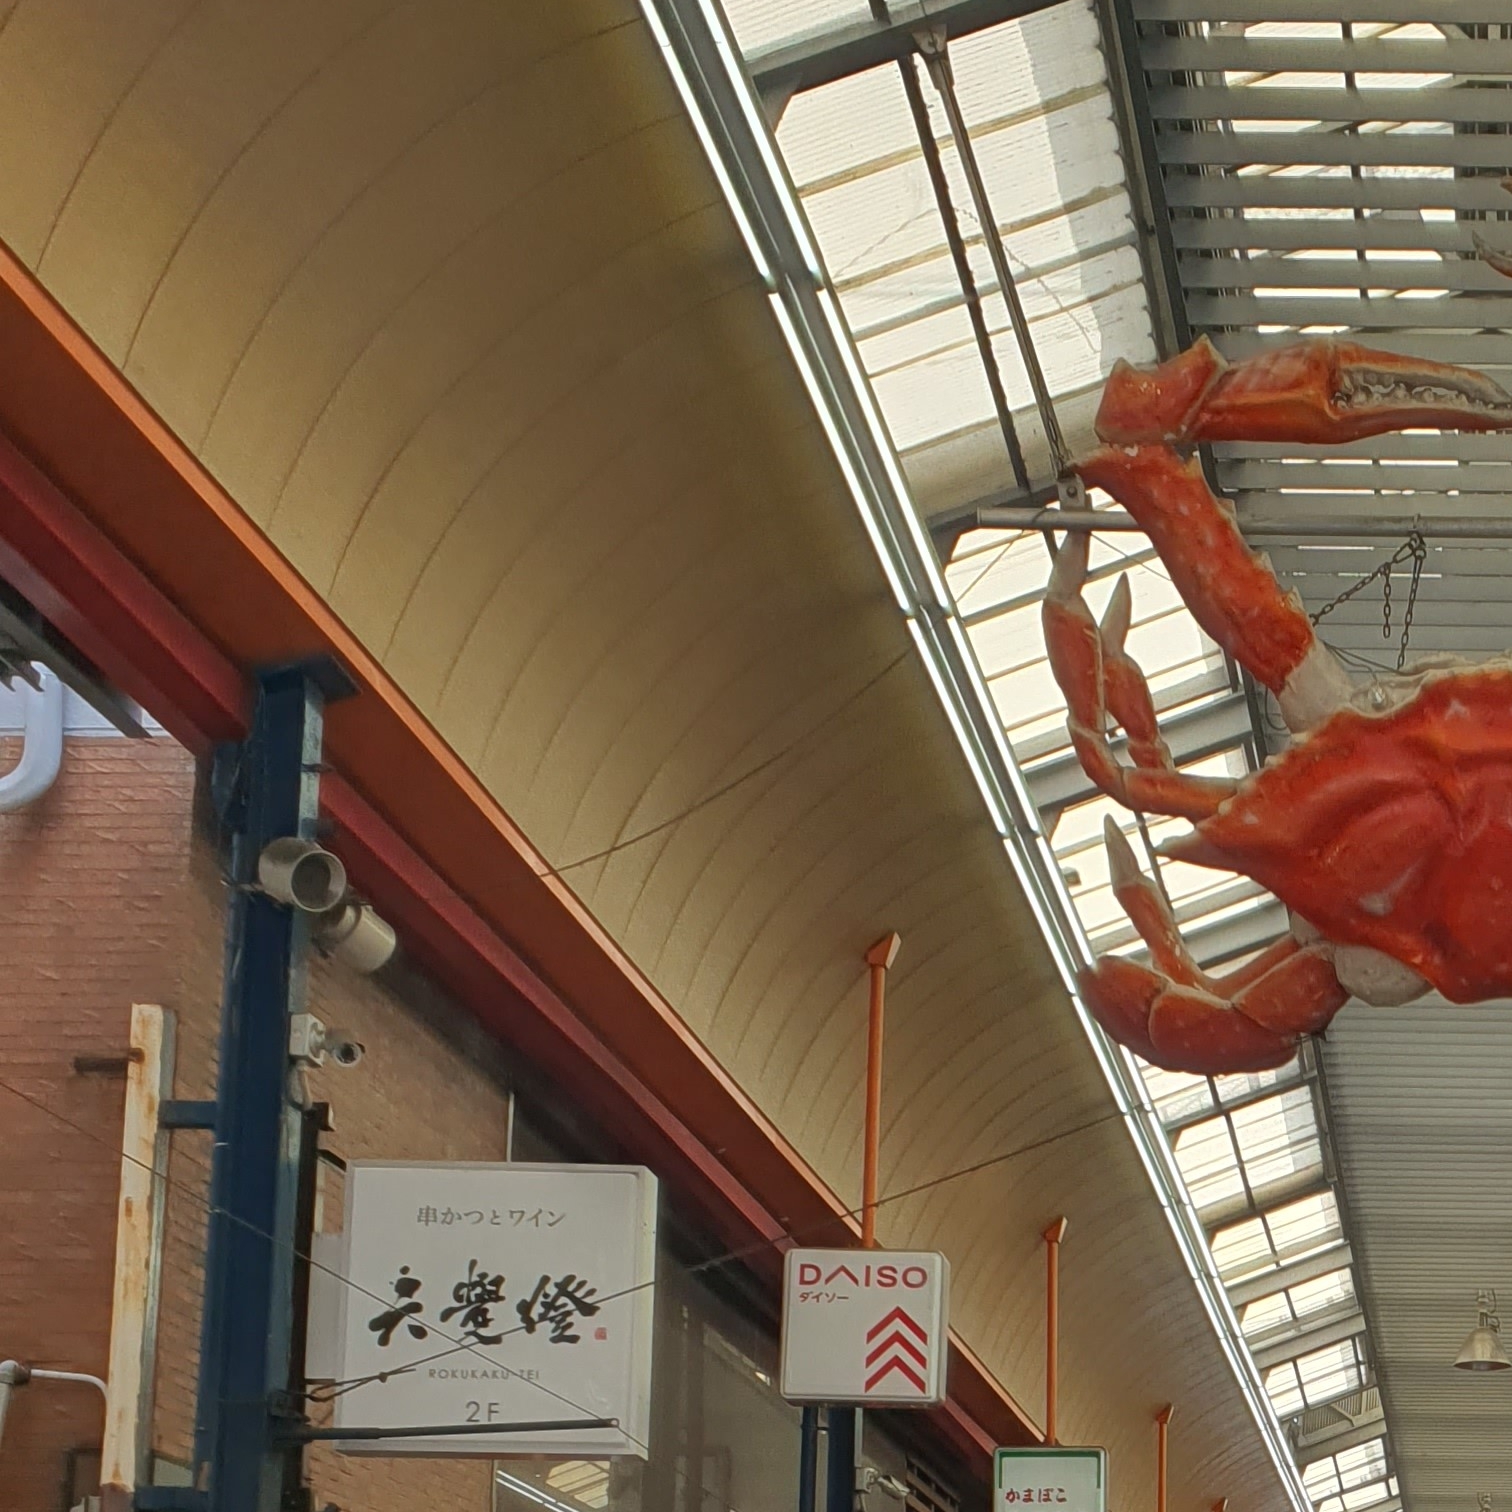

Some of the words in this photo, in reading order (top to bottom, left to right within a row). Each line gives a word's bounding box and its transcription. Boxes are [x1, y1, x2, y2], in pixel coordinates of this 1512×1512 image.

[417, 1205, 566, 1228] 串かつとワイン
[798, 1262, 928, 1288] DAISO
[799, 1291, 849, 1304] ダイソー
[465, 1400, 501, 1423] 2F
[1005, 1487, 1068, 1504] かまぼこ
